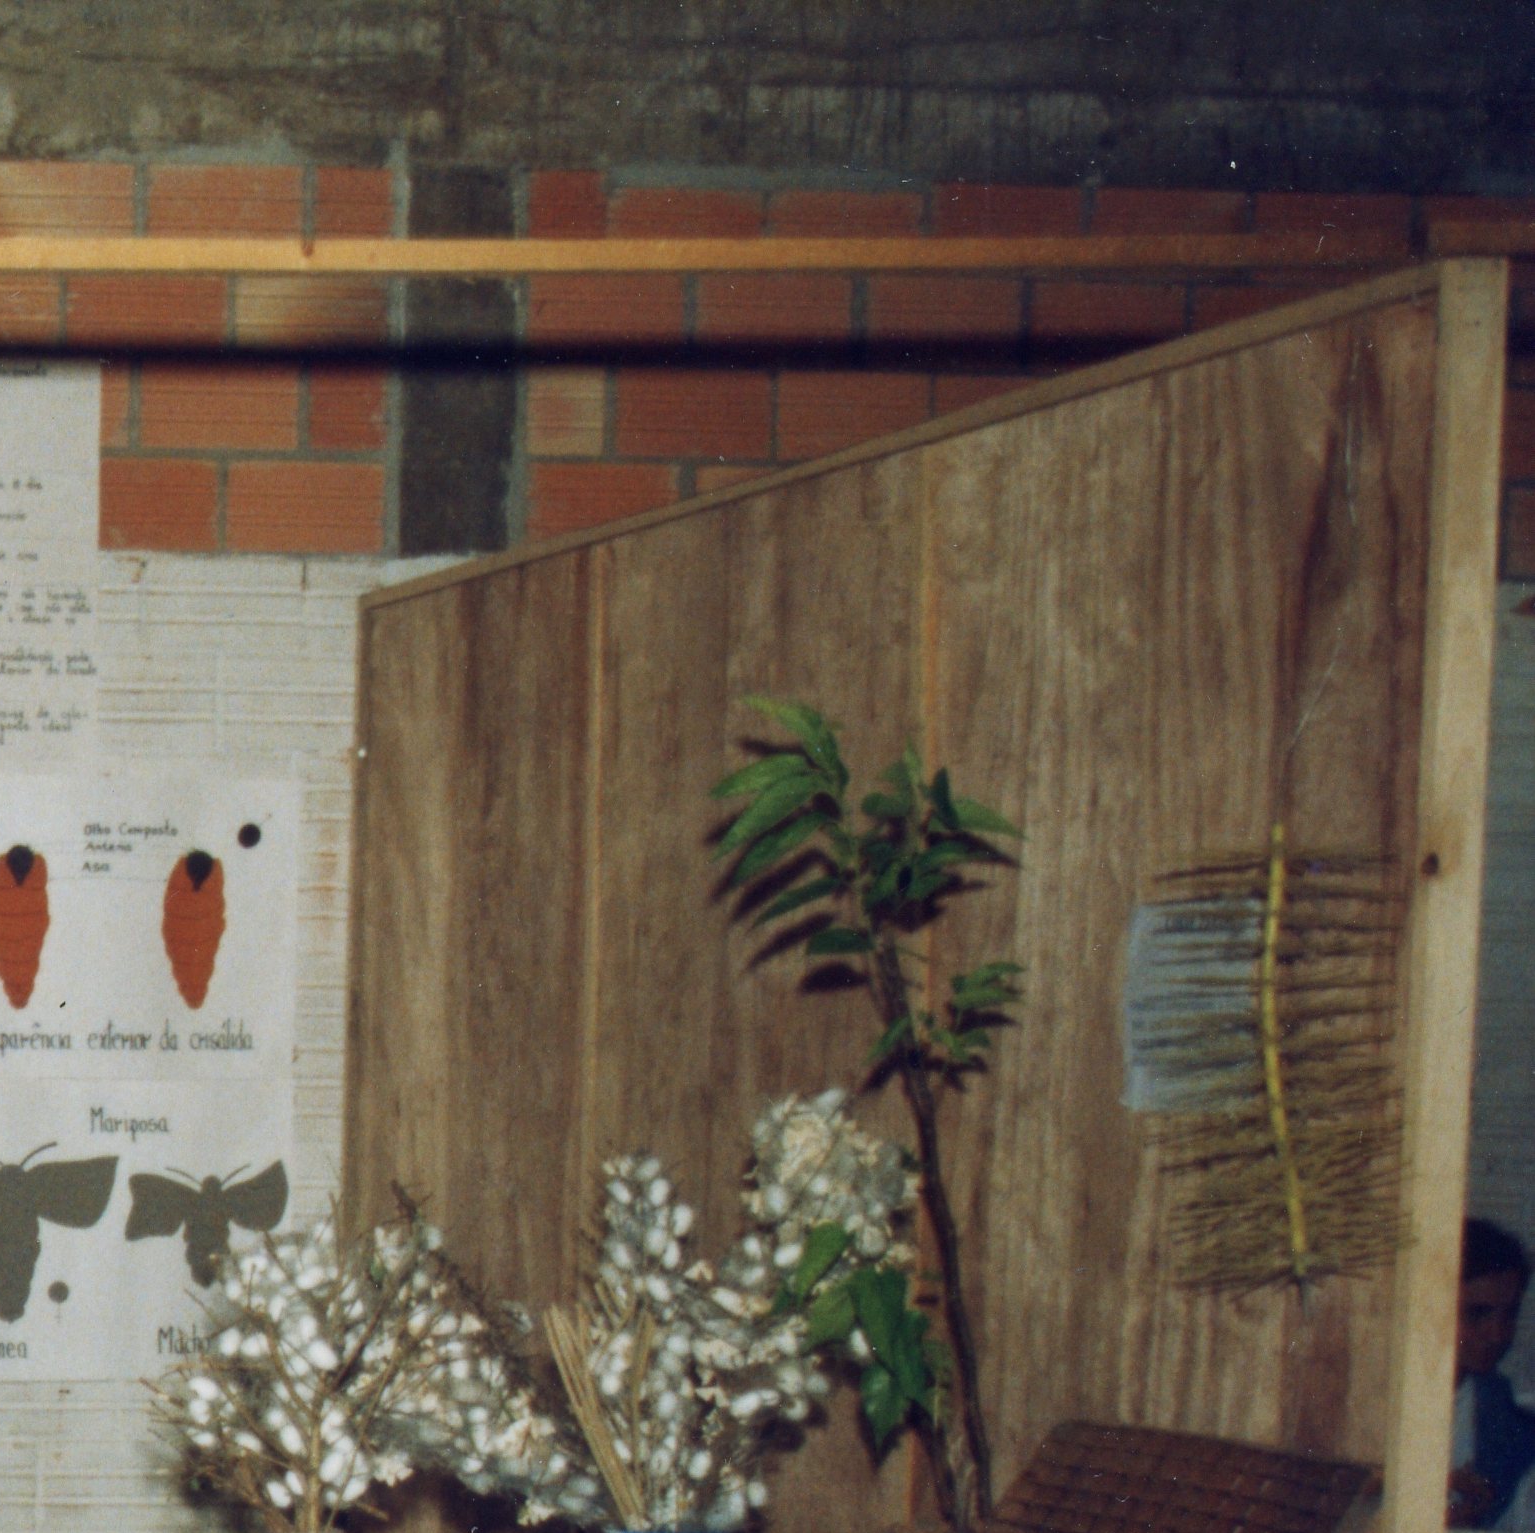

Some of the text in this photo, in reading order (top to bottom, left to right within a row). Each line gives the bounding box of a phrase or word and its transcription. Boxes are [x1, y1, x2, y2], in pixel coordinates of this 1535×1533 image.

[86, 1019, 153, 1052] exterior
[158, 1022, 180, 1051] da
[187, 1018, 254, 1052] crisálida
[89, 1106, 170, 1143] Mariposa
